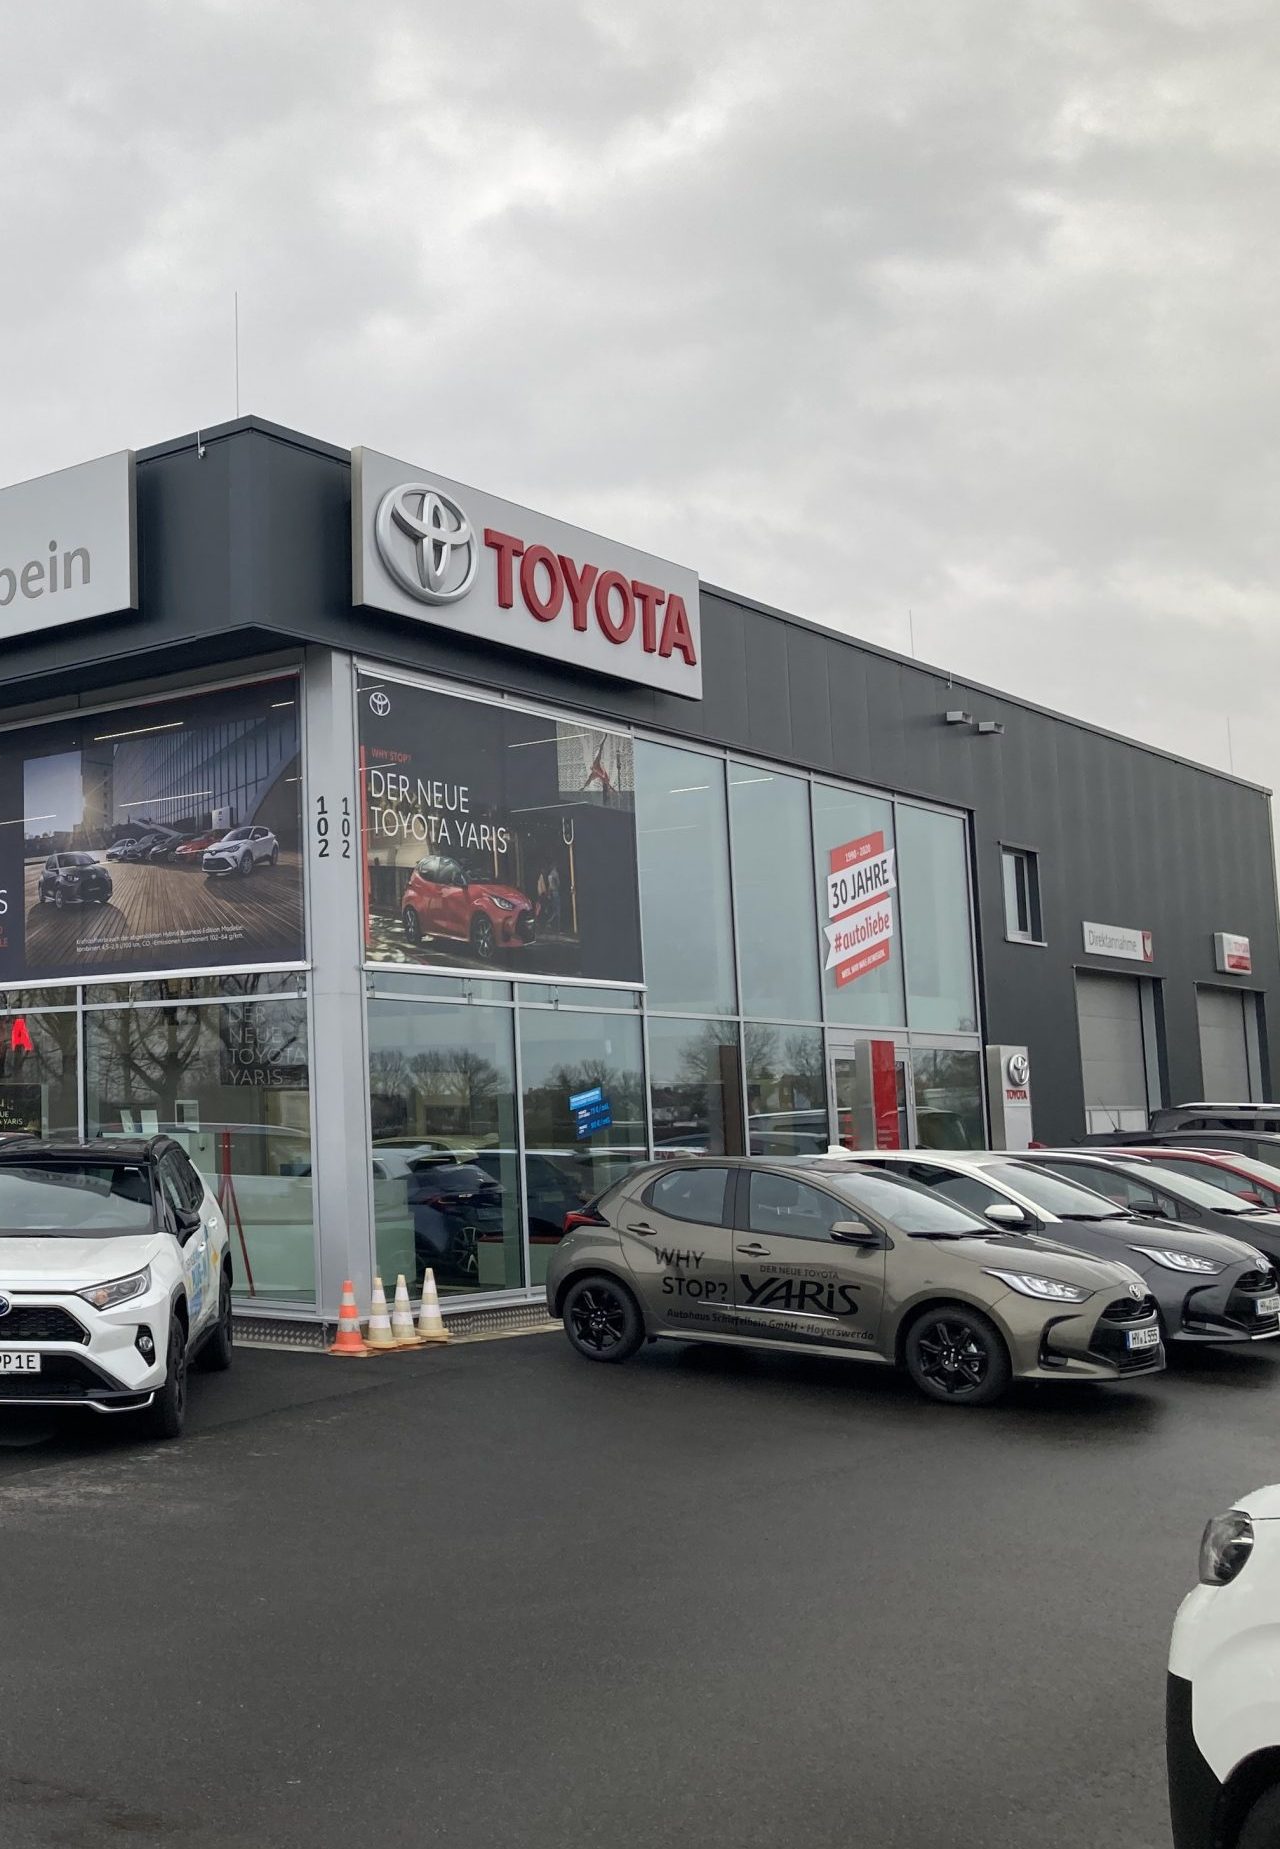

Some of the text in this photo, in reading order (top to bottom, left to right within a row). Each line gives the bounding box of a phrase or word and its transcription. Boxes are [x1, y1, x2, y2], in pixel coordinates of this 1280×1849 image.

[484, 528, 697, 666] TOYOTA
[371, 770, 470, 813] DER NEUE
[370, 806, 508, 854] TOYOTA YARIS
[831, 859, 889, 909] 30 JAHRE
[834, 911, 890, 953] #autoliebe
[228, 1005, 267, 1023] DER
[229, 1026, 281, 1044] NEUE
[228, 1048, 306, 1065] TOYOTA
[228, 1069, 283, 1086] YARIS
[1006, 1089, 1028, 1100] TOYOTA
[4, 1118, 23, 1126] YARIS
[654, 1247, 705, 1269] WHY
[760, 1265, 839, 1279] DER NEUE TOYOTA
[662, 1276, 728, 1301] STOP?
[667, 1308, 710, 1321] Autohaus
[770, 1319, 798, 1331] GmbH
[806, 1323, 874, 1341] Hoyerswerda
